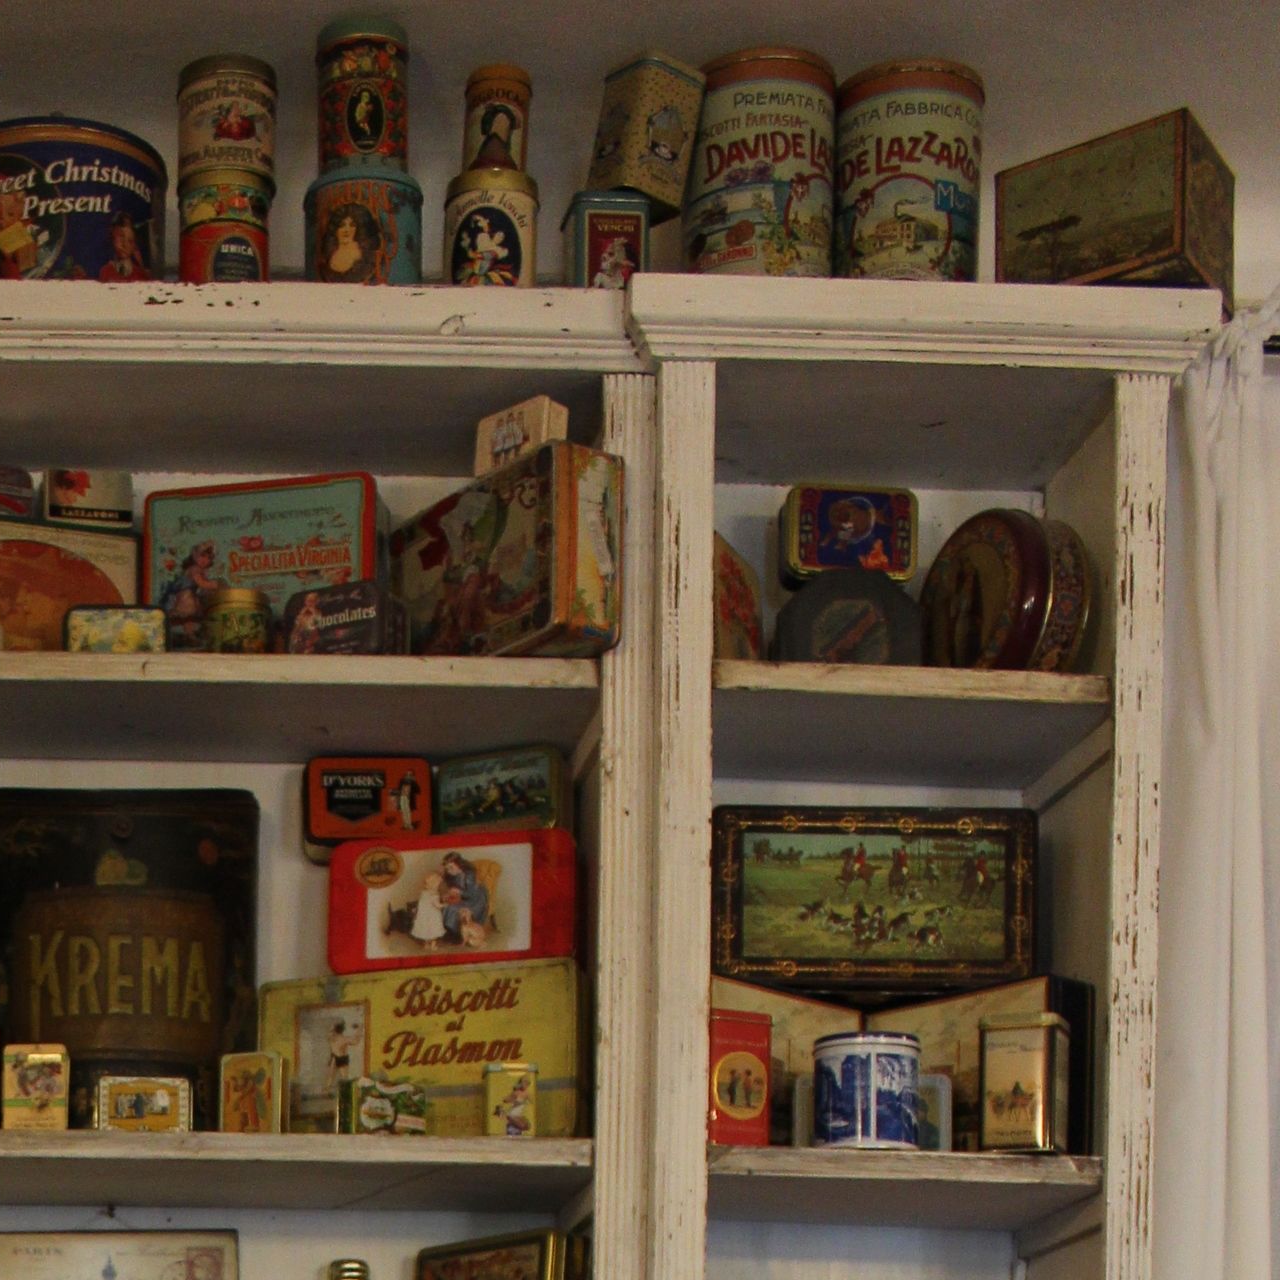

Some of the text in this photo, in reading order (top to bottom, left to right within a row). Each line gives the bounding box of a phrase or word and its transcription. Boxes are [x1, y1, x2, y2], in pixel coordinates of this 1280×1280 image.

[734, 92, 816, 110] PREMIATA
[886, 101, 962, 120] FABBRICA
[704, 130, 805, 185] DAVIDE
[44, 158, 153, 202] Christmas
[20, 193, 113, 221] Present
[28, 929, 211, 1042] KREMA
[394, 977, 521, 1019] Biscotti
[445, 1016, 465, 1032] al
[383, 1031, 522, 1069] Plasmon
